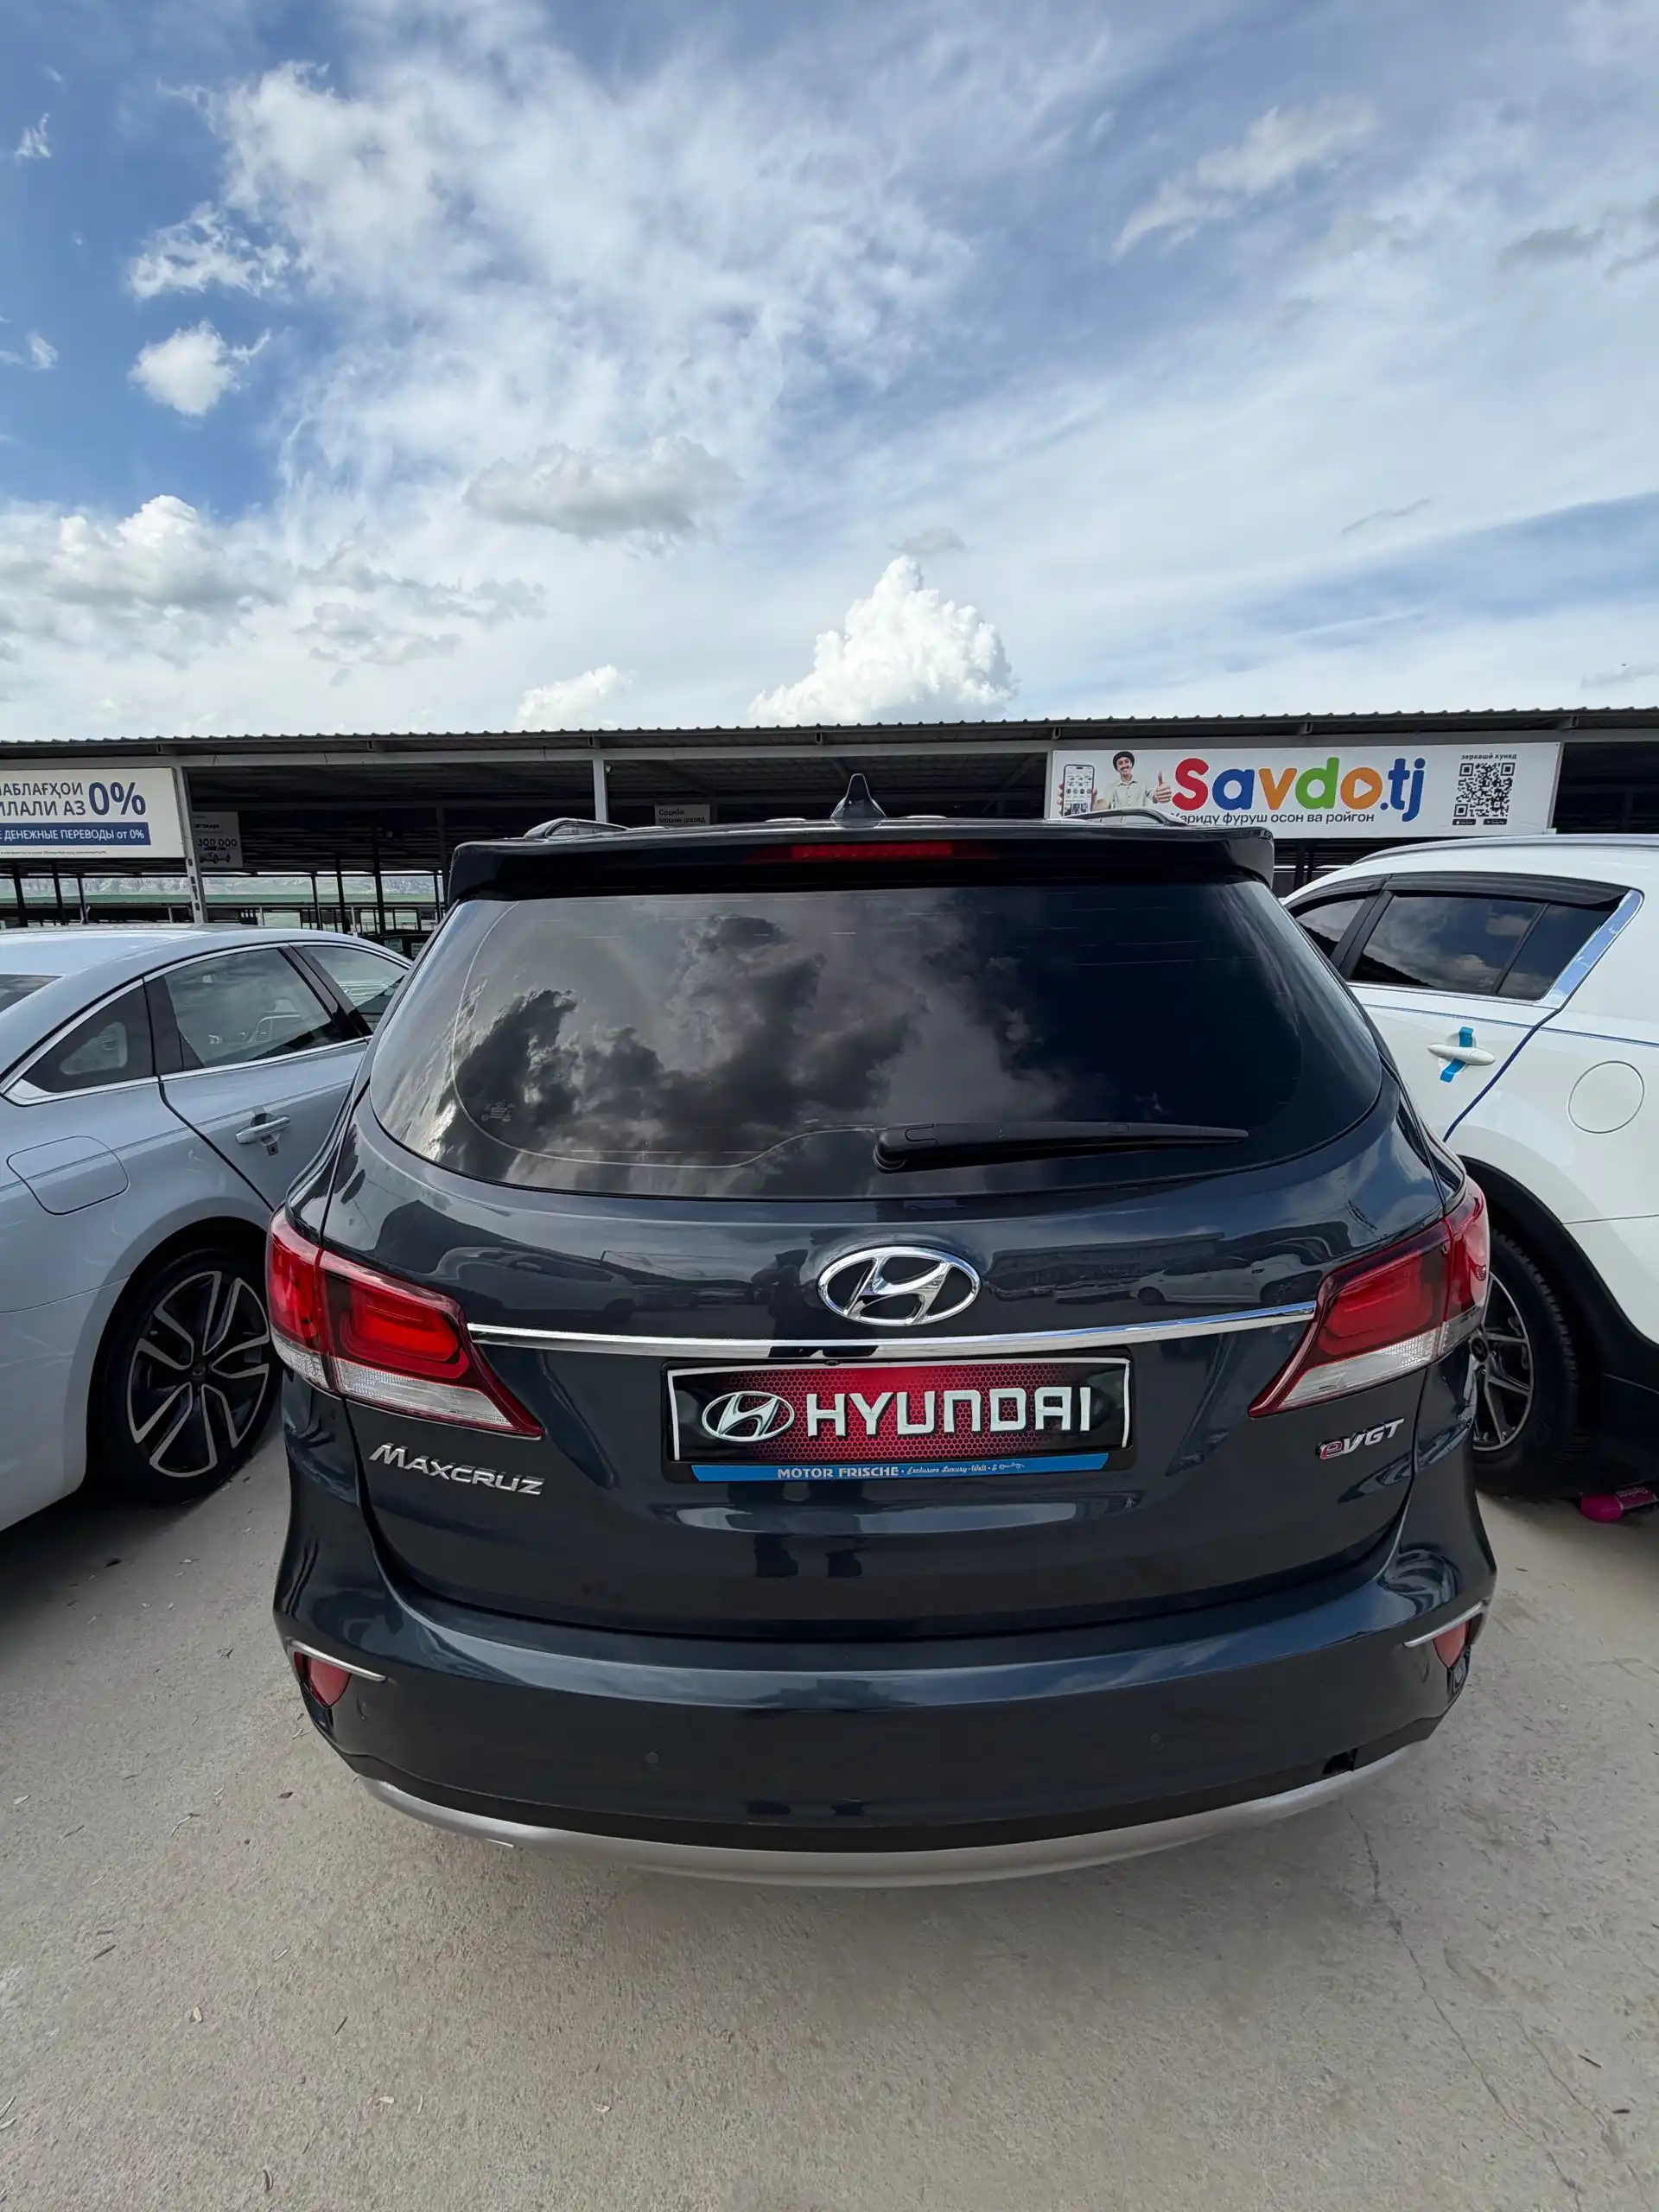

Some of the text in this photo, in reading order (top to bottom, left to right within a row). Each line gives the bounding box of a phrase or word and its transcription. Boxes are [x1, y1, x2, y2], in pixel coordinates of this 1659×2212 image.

[88, 781, 146, 816] 0%
[1172, 757, 1426, 822] Savdo.tj
[63, 801, 86, 816] АЗ
[1223, 812, 1268, 825] фуруш
[1271, 814, 1304, 823] осон
[1307, 814, 1323, 823] ва
[1326, 811, 1375, 824] ройгон
[4, 830, 59, 842] ДЕНЕЖНЫЕ
[60, 830, 114, 842] ПЕРЕВОДЫ
[130, 830, 144, 839] 0%
[806, 1386, 1091, 1437] HYUNDAI
[369, 1443, 544, 1496] MAXCRUZ
[778, 1467, 834, 1478] MOTOR
[838, 1466, 899, 1478] FRISCHE
